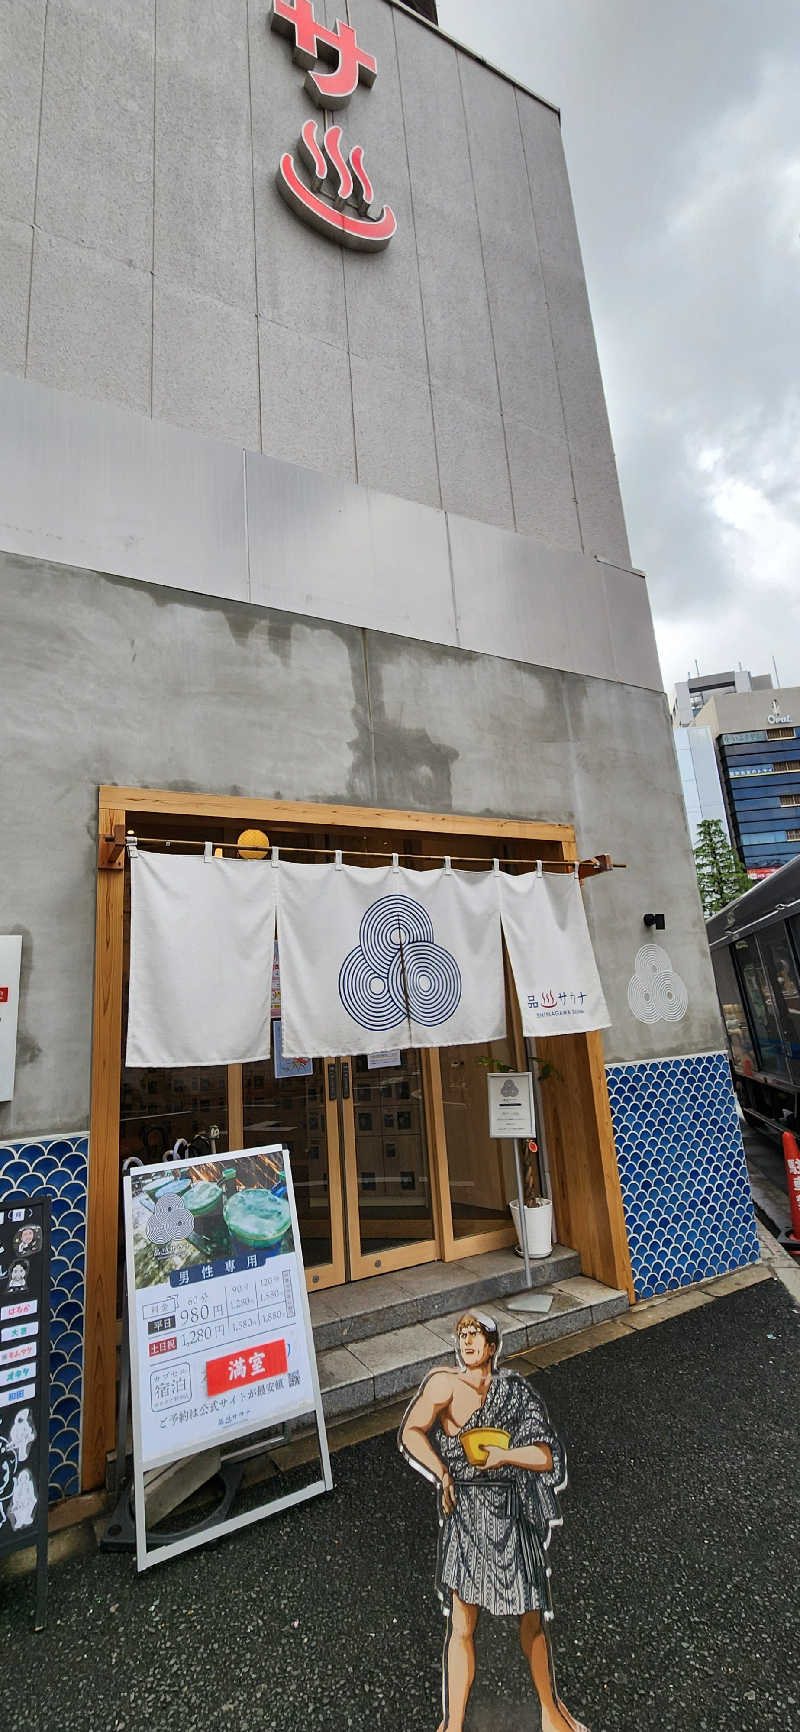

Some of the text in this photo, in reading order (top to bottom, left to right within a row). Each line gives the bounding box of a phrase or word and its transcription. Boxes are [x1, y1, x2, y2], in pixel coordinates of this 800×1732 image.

[179, 1254, 258, 1285] 男性専用
[153, 1317, 172, 1332] 平日
[150, 1341, 177, 1353] 土日祝
[228, 1351, 267, 1382] 満室
[154, 1376, 187, 1399] 宿泊
